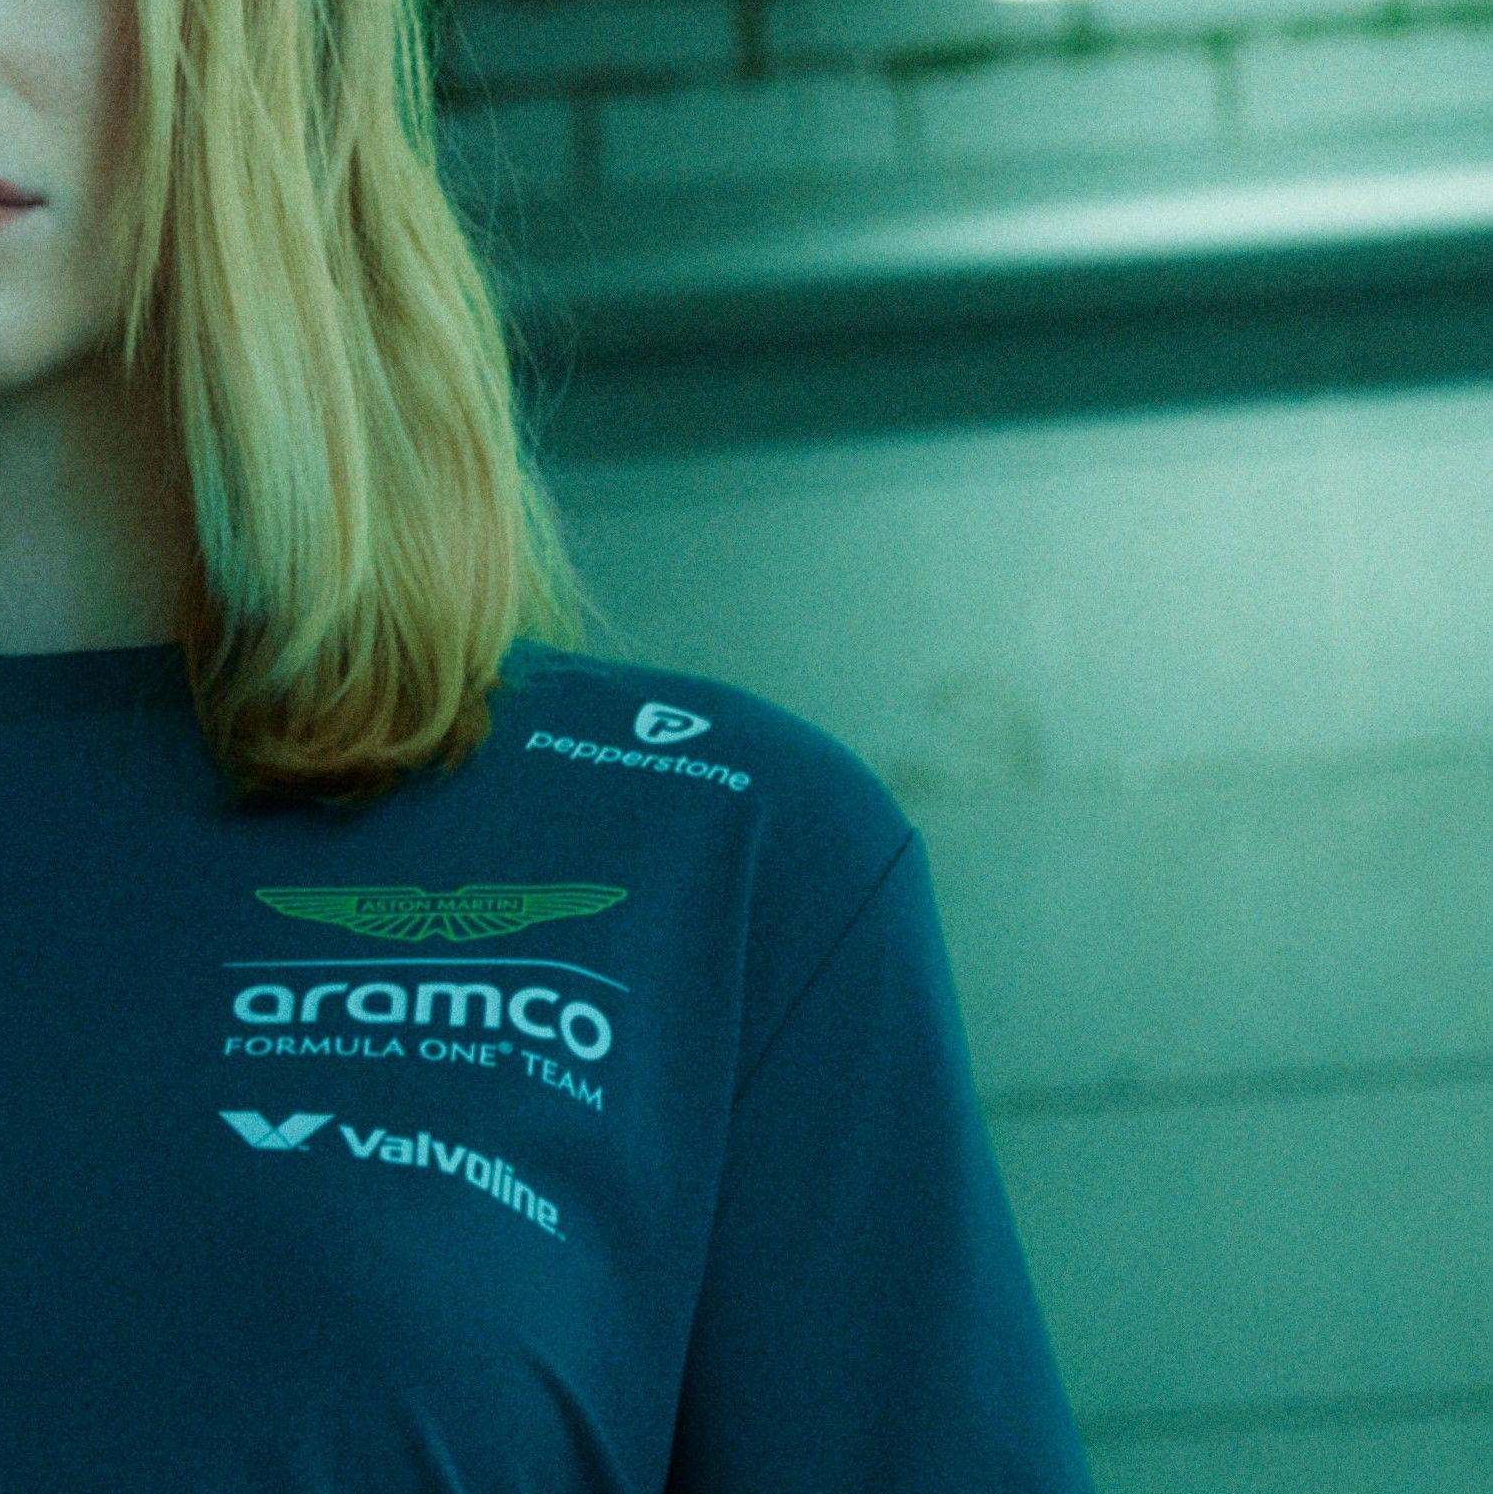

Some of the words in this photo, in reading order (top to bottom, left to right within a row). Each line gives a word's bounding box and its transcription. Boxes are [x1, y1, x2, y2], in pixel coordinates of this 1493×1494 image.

[524, 730, 752, 793] pepperstone
[362, 899, 432, 913] ASTON
[437, 899, 519, 913] MARTIN
[232, 981, 613, 1062] aramco
[224, 1036, 406, 1057] FORMULA
[520, 1049, 604, 1112] TEAM
[339, 1123, 559, 1237] Valvoline
